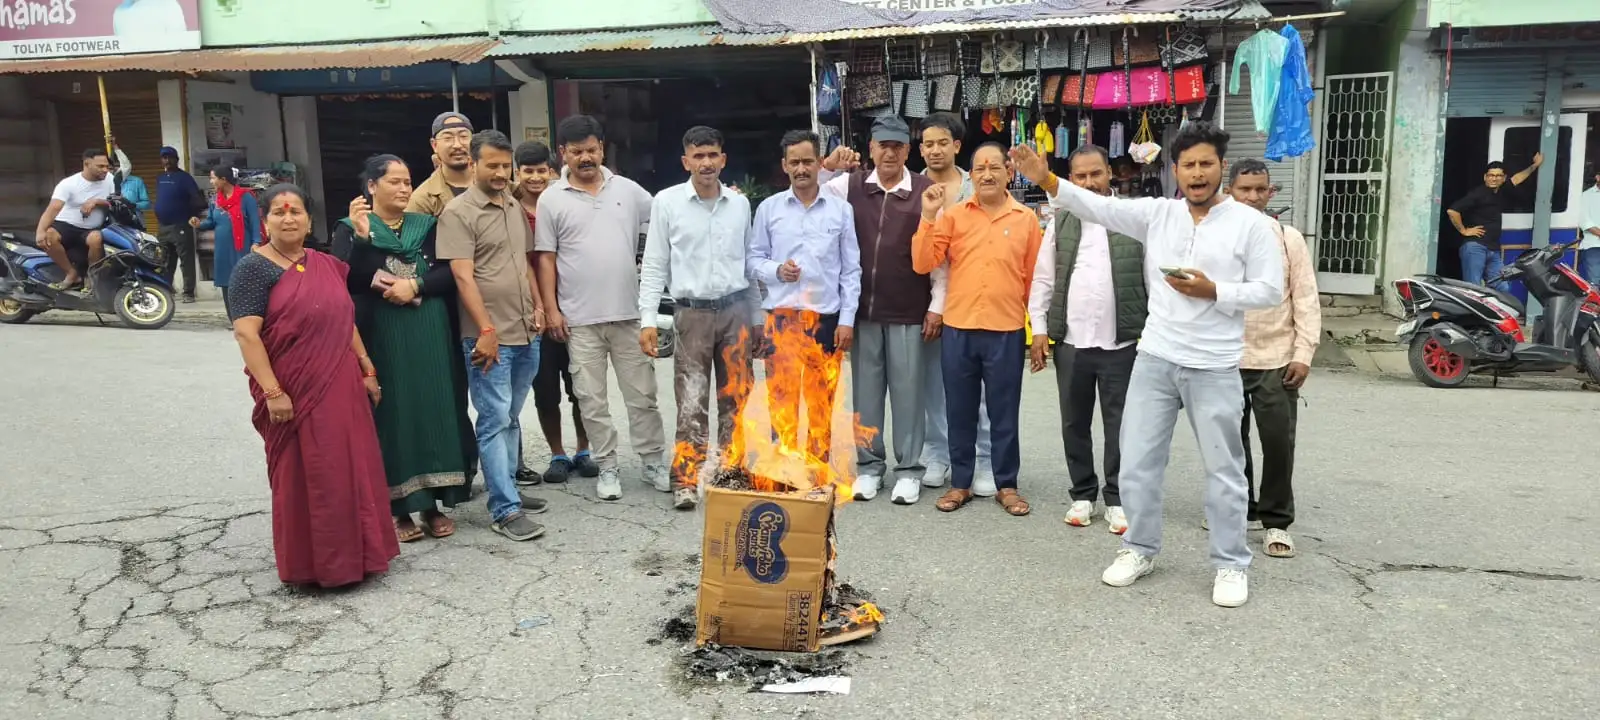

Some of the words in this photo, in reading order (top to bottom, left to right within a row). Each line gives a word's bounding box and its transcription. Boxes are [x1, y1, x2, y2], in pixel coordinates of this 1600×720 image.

[887, 0, 959, 10] CENTER
[13, 43, 53, 54] TOLIYA
[56, 40, 120, 53] FOOTWEAR
[749, 528, 758, 557] pants
[787, 593, 796, 622] Quantity
[797, 591, 811, 652] 3824416
